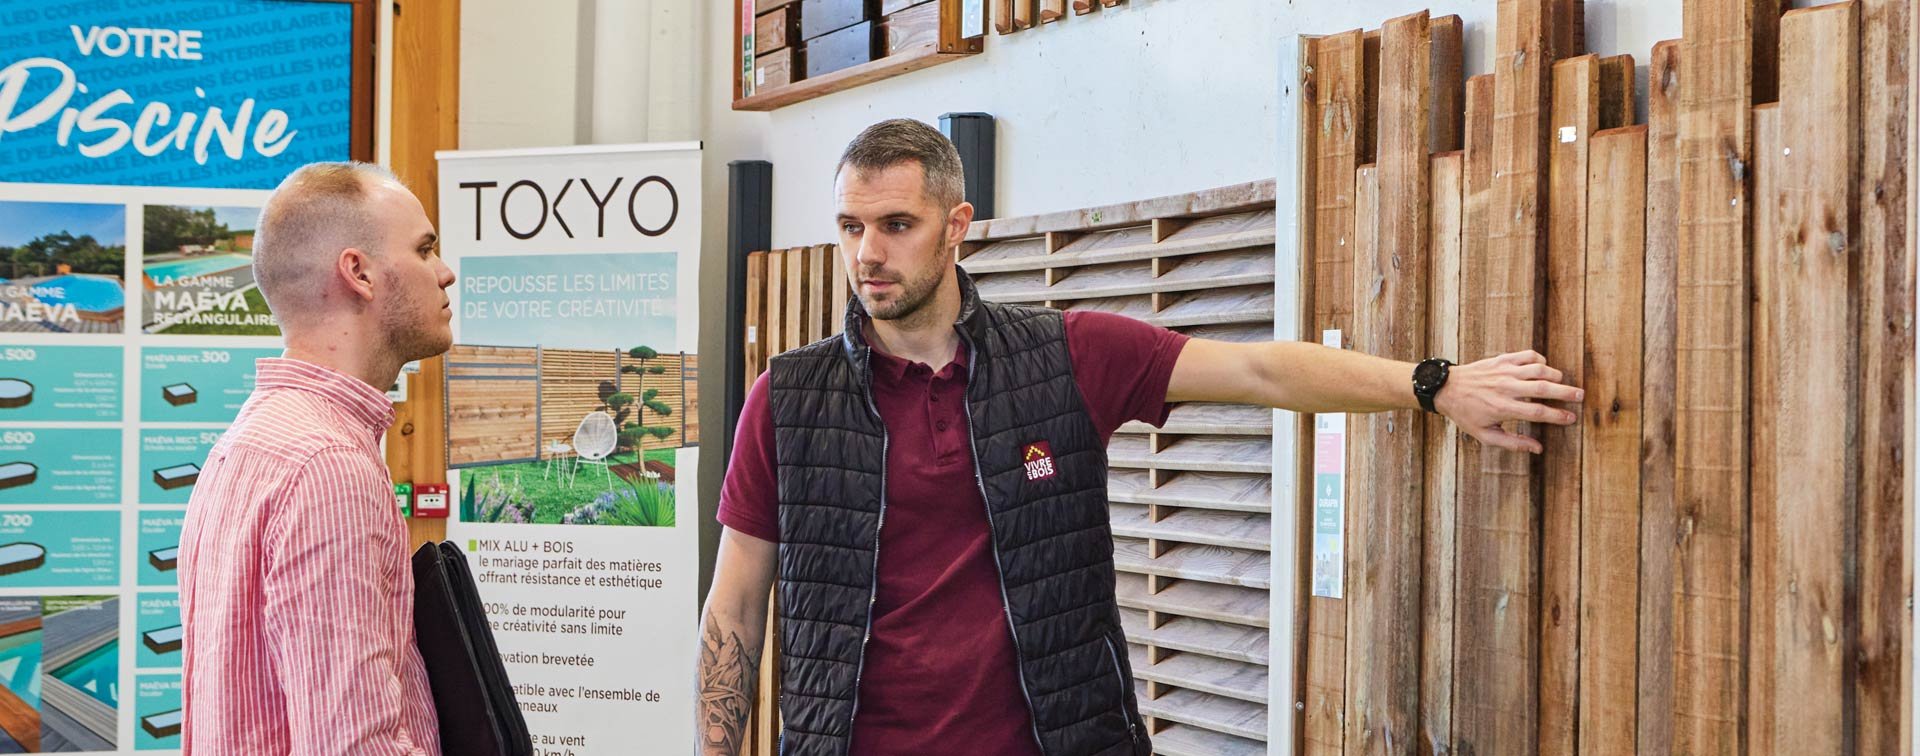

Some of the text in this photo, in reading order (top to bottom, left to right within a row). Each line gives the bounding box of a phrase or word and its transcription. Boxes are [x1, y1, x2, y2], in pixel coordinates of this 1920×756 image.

[70, 25, 203, 60] VOTRE
[459, 175, 679, 240] TOKYO
[153, 275, 235, 288] LA GAMME
[465, 273, 670, 294] REPOUSSE LES LIMITES
[6, 286, 65, 299] GAMME
[154, 285, 249, 312] MAÉVA
[465, 295, 664, 319] DE VOTRE CRÉATIVITÉ
[153, 312, 279, 326] RECTANGULAIRE
[5, 348, 36, 361] 500
[201, 350, 230, 363] 300
[3, 431, 36, 444] 600
[200, 432, 220, 445] 50
[1024, 457, 1052, 471] VIVRE
[1031, 465, 1054, 479] BOIS
[2, 514, 33, 527] 700
[479, 540, 499, 551] MIX
[504, 540, 528, 552] ALU
[544, 541, 574, 553] BOIS
[479, 556, 662, 572] le mariage parfait des matières
[479, 571, 663, 591] offrant résistance et esthétique
[482, 602, 626, 621] 00% de modularité pour
[503, 620, 557, 633] créativité
[561, 623, 587, 634] sans
[591, 622, 623, 636] limite
[500, 650, 595, 667] vation brevetée
[512, 683, 661, 703] atible avec l'ensemble de
[542, 735, 556, 745] au
[560, 735, 585, 747] vent
